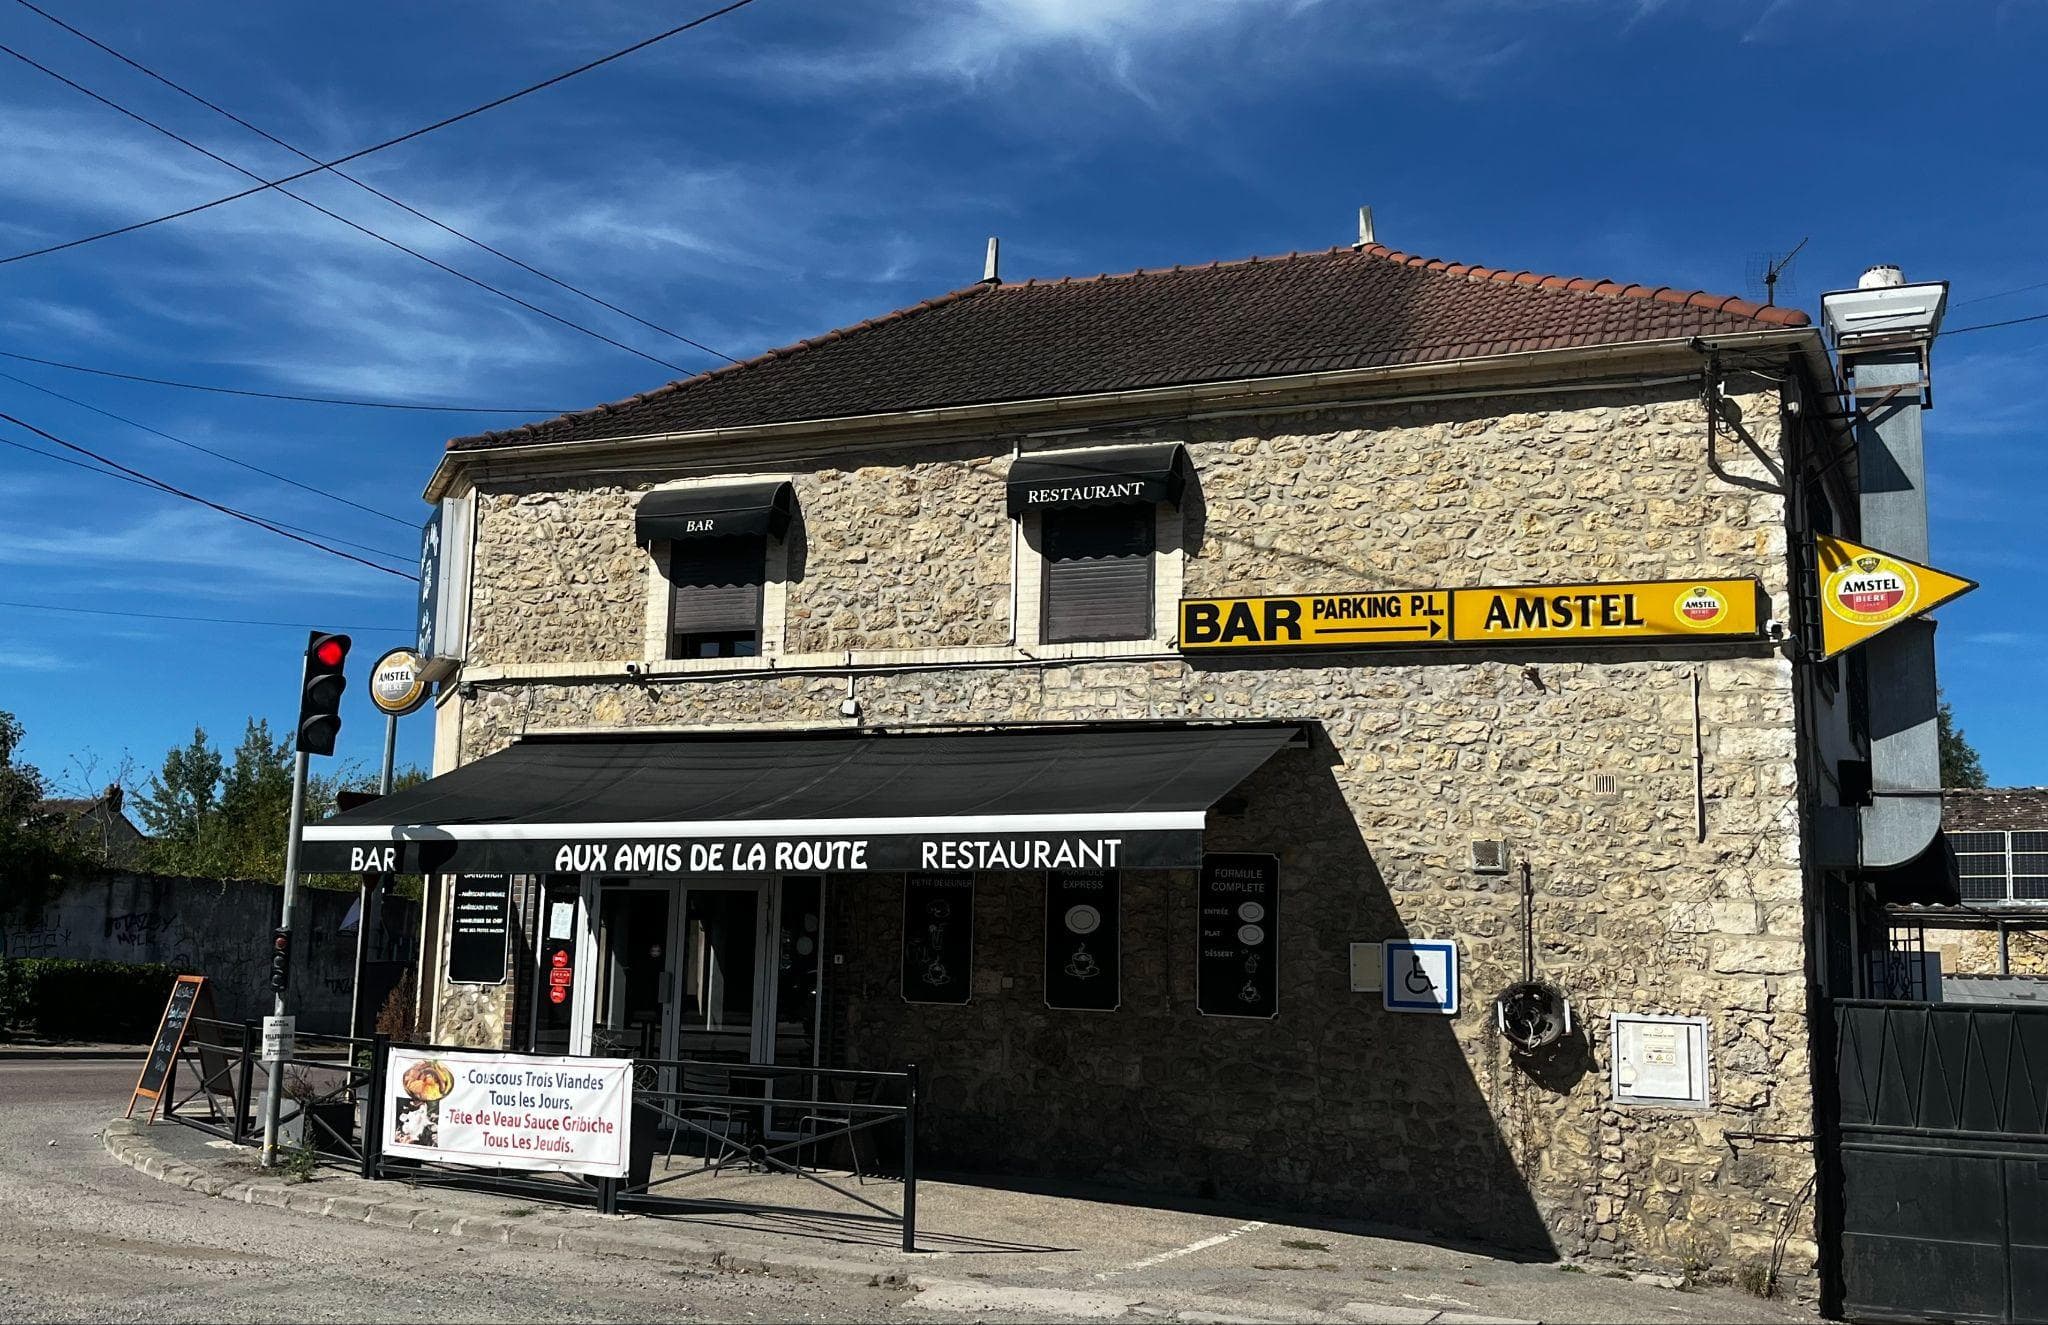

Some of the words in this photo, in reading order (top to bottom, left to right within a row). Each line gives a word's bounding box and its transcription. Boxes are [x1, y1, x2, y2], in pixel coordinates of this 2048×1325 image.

[1027, 482, 1145, 503] RESTAURANT
[686, 519, 714, 532] BAR
[1844, 578, 1900, 593] AMSTEL
[1484, 593, 1646, 631] AMSTEL
[1685, 600, 1717, 608] AMSTEL
[1185, 600, 1302, 643] BAR
[1312, 596, 1402, 619] PARKING
[1411, 594, 1445, 616] P.L.
[379, 670, 411, 682] AMSTEL
[350, 846, 397, 871] BAR
[555, 844, 607, 871] AUX
[613, 844, 682, 871] AMIS
[689, 843, 724, 871] DE
[732, 842, 766, 871] LA
[774, 841, 868, 870] ROUTE
[921, 838, 1122, 869] RESTAURANT
[1215, 868, 1264, 879] FORMULE
[468, 1069, 522, 1086] Couscous
[525, 1071, 553, 1088] Trois
[555, 1073, 604, 1090] Viandes
[489, 1090, 516, 1107] Tous
[519, 1092, 536, 1109] les
[538, 1093, 573, 1110] Jours.
[475, 1110, 491, 1126] de
[493, 1111, 521, 1128] Veau
[524, 1113, 560, 1130] Sauce
[562, 1115, 614, 1134] Gribiche
[483, 1131, 509, 1148] Tous
[512, 1132, 532, 1149] Les
[533, 1134, 574, 1153] Jeudis.
